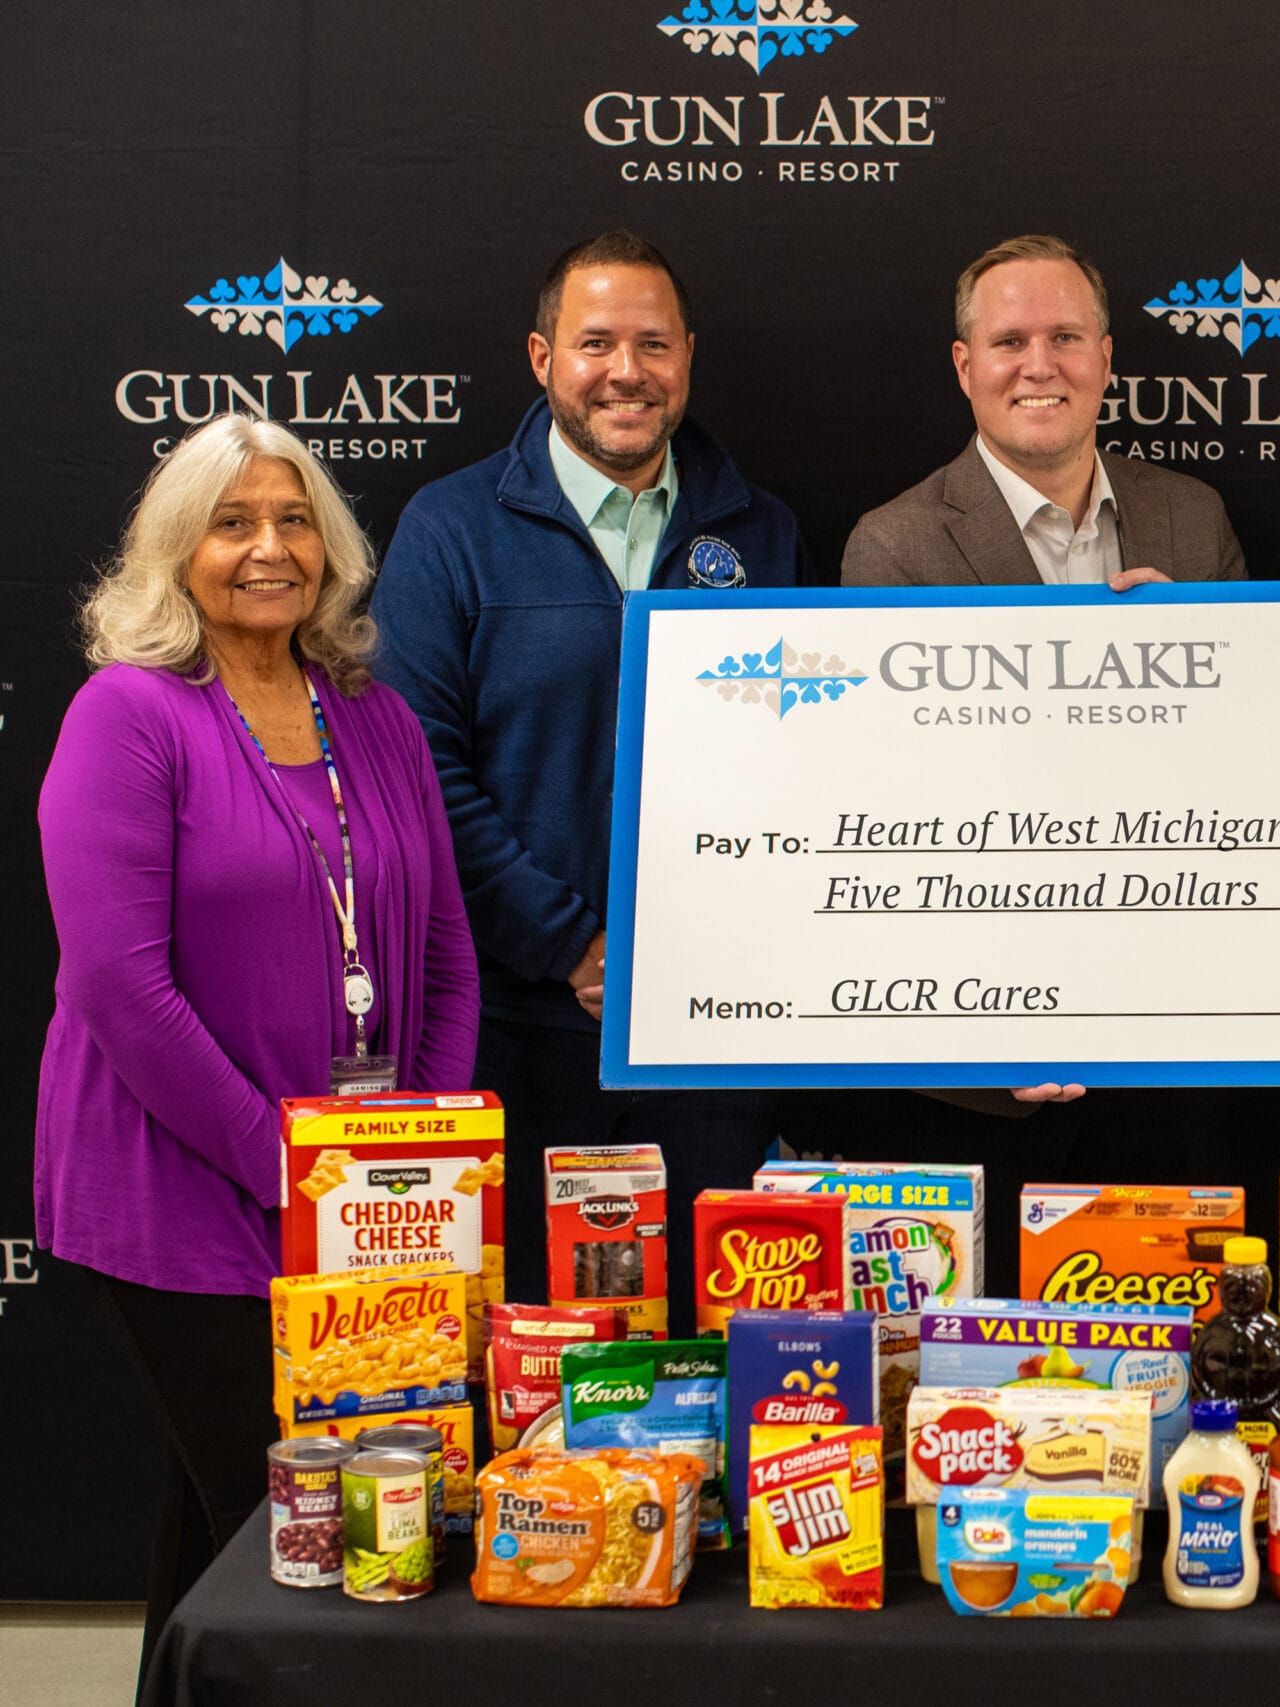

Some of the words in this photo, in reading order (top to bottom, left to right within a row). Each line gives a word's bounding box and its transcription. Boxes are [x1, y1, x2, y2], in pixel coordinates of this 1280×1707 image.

[584, 91, 745, 146] GUN
[759, 92, 935, 146] LAKE
[621, 161, 743, 182] CASINO
[779, 161, 900, 182] RESORT
[115, 369, 273, 425] GUN
[287, 371, 462, 424] LAKE
[307, 438, 428, 460] RESORT
[879, 640, 1032, 692] GUN
[1047, 639, 1222, 690] LAKE
[913, 705, 1032, 726] CASINO
[1066, 704, 1188, 725] RESORT
[695, 833, 751, 859] Pay
[762, 832, 810, 855] To:
[832, 813, 944, 848] Heart
[956, 810, 999, 853] of
[1007, 812, 1100, 845] West
[822, 875, 901, 910] Five
[916, 873, 1107, 909] Thousand
[1116, 871, 1259, 907] Dollars
[689, 997, 793, 1019] Memo:
[831, 979, 939, 1012] GLCR
[953, 978, 1061, 1011] Cares
[344, 1120, 410, 1136] FAMILY
[415, 1119, 456, 1134] SIZE
[556, 1179, 574, 1199] 20
[900, 1185, 950, 1206] SIZE
[340, 1199, 455, 1226] CHEDDAR
[354, 1225, 442, 1251] CHEESE
[347, 1252, 388, 1268] SNACK
[393, 1250, 455, 1265] CRACKERS
[706, 1229, 823, 1299] Stove
[1041, 1250, 1217, 1306] Reese's
[751, 1273, 806, 1310] Top
[309, 1280, 450, 1351] Velveeta
[933, 1318, 962, 1333] 22
[977, 1318, 1078, 1345] VALUE
[1090, 1323, 1173, 1348] PACK
[512, 1342, 548, 1354] MASHED
[778, 1341, 822, 1353] ELBOWS
[1127, 1367, 1169, 1384] FRUIT
[572, 1380, 650, 1404] Knorr
[763, 1401, 837, 1423] Barilla
[1244, 1423, 1269, 1433] MORE
[918, 1420, 1015, 1460] Snack
[781, 1441, 850, 1472] ORIGINAL
[1044, 1445, 1088, 1460] Vanilla
[1109, 1453, 1141, 1471] 60%
[753, 1460, 783, 1488] 14
[940, 1449, 1015, 1482] pack
[1106, 1467, 1139, 1482] MORE
[294, 1495, 338, 1506] KIDNEY
[298, 1503, 336, 1514] BEANS
[496, 1491, 545, 1518] Top
[636, 1506, 650, 1530] 5
[944, 1505, 958, 1519] 4
[387, 1526, 422, 1541] BEANS
[391, 1518, 417, 1532] LIMA
[498, 1512, 589, 1537] Ramen
[973, 1527, 1005, 1542] Dole
[1024, 1528, 1088, 1541] mandarin
[1195, 1521, 1224, 1532] REAL
[519, 1535, 581, 1551] CHICKEN
[1024, 1541, 1077, 1555] oranges
[1179, 1531, 1239, 1549] MAYO
